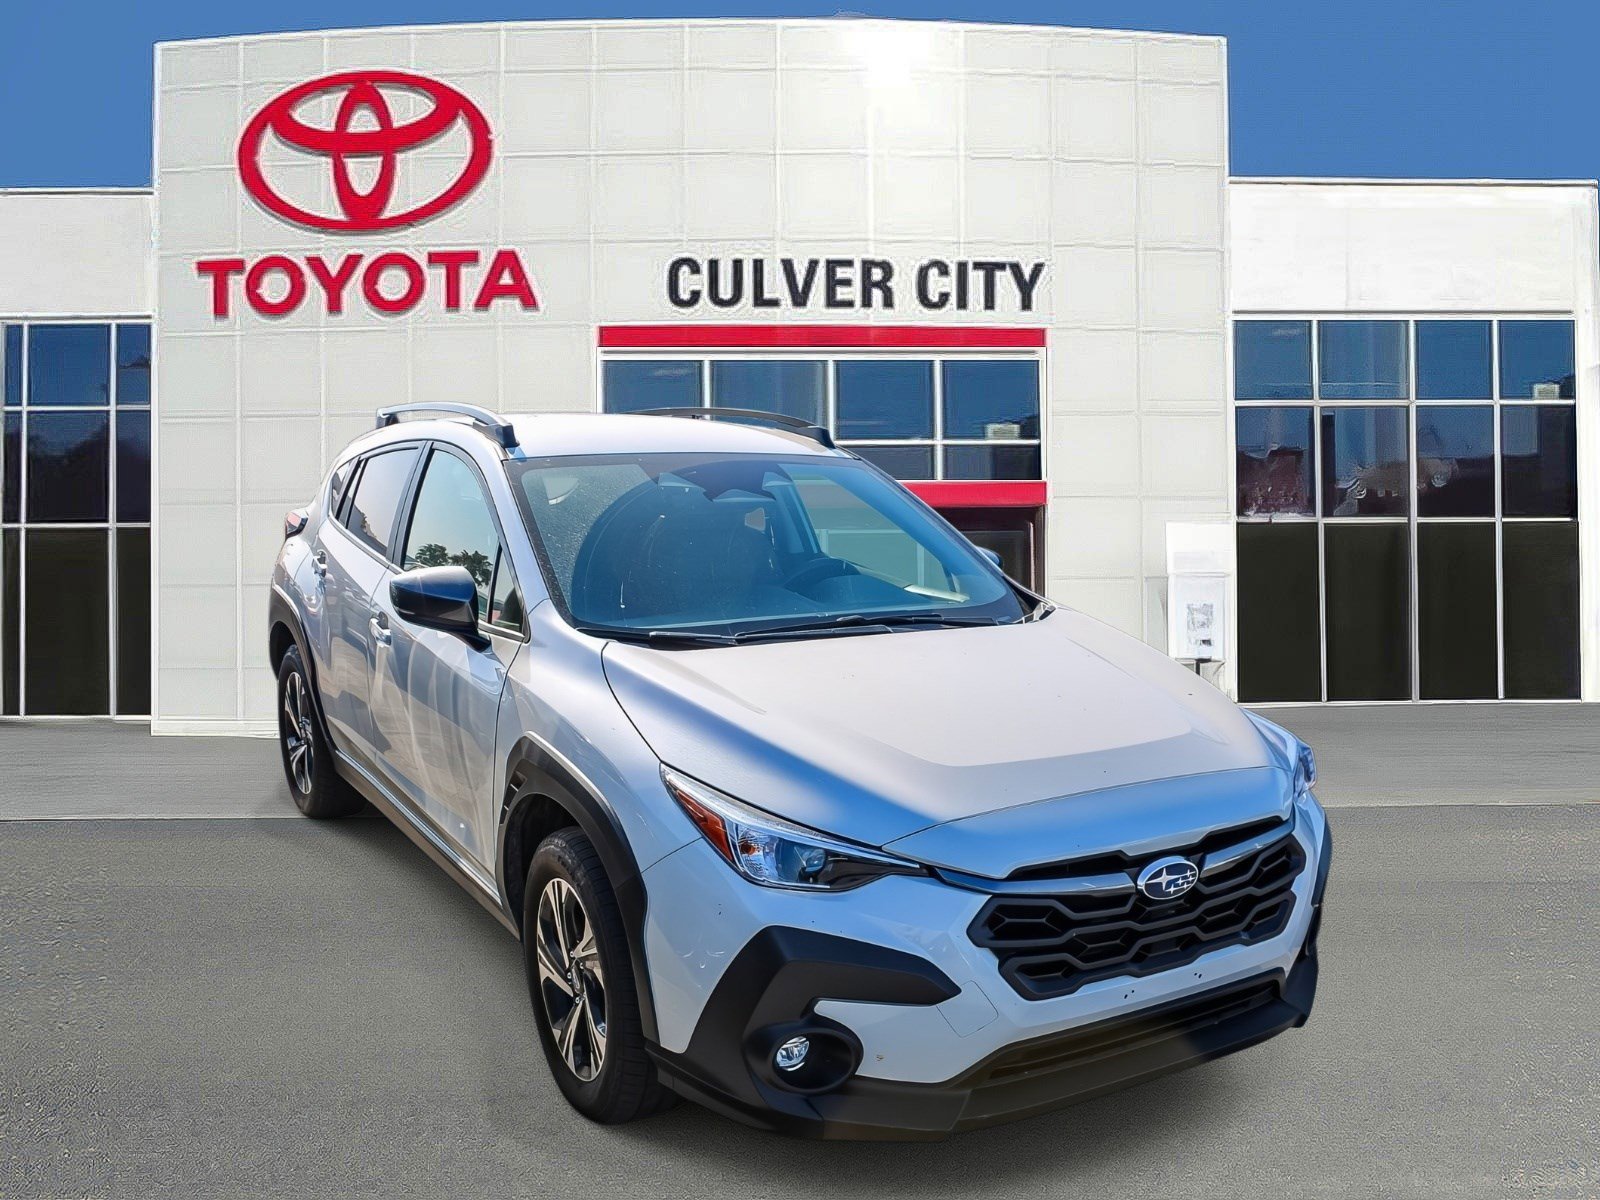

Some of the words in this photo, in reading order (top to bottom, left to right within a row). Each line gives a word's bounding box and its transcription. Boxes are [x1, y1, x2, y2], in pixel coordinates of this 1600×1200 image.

[197, 249, 538, 317] TOYOTA
[668, 257, 893, 309] CULVER
[917, 259, 1044, 311] CITY
